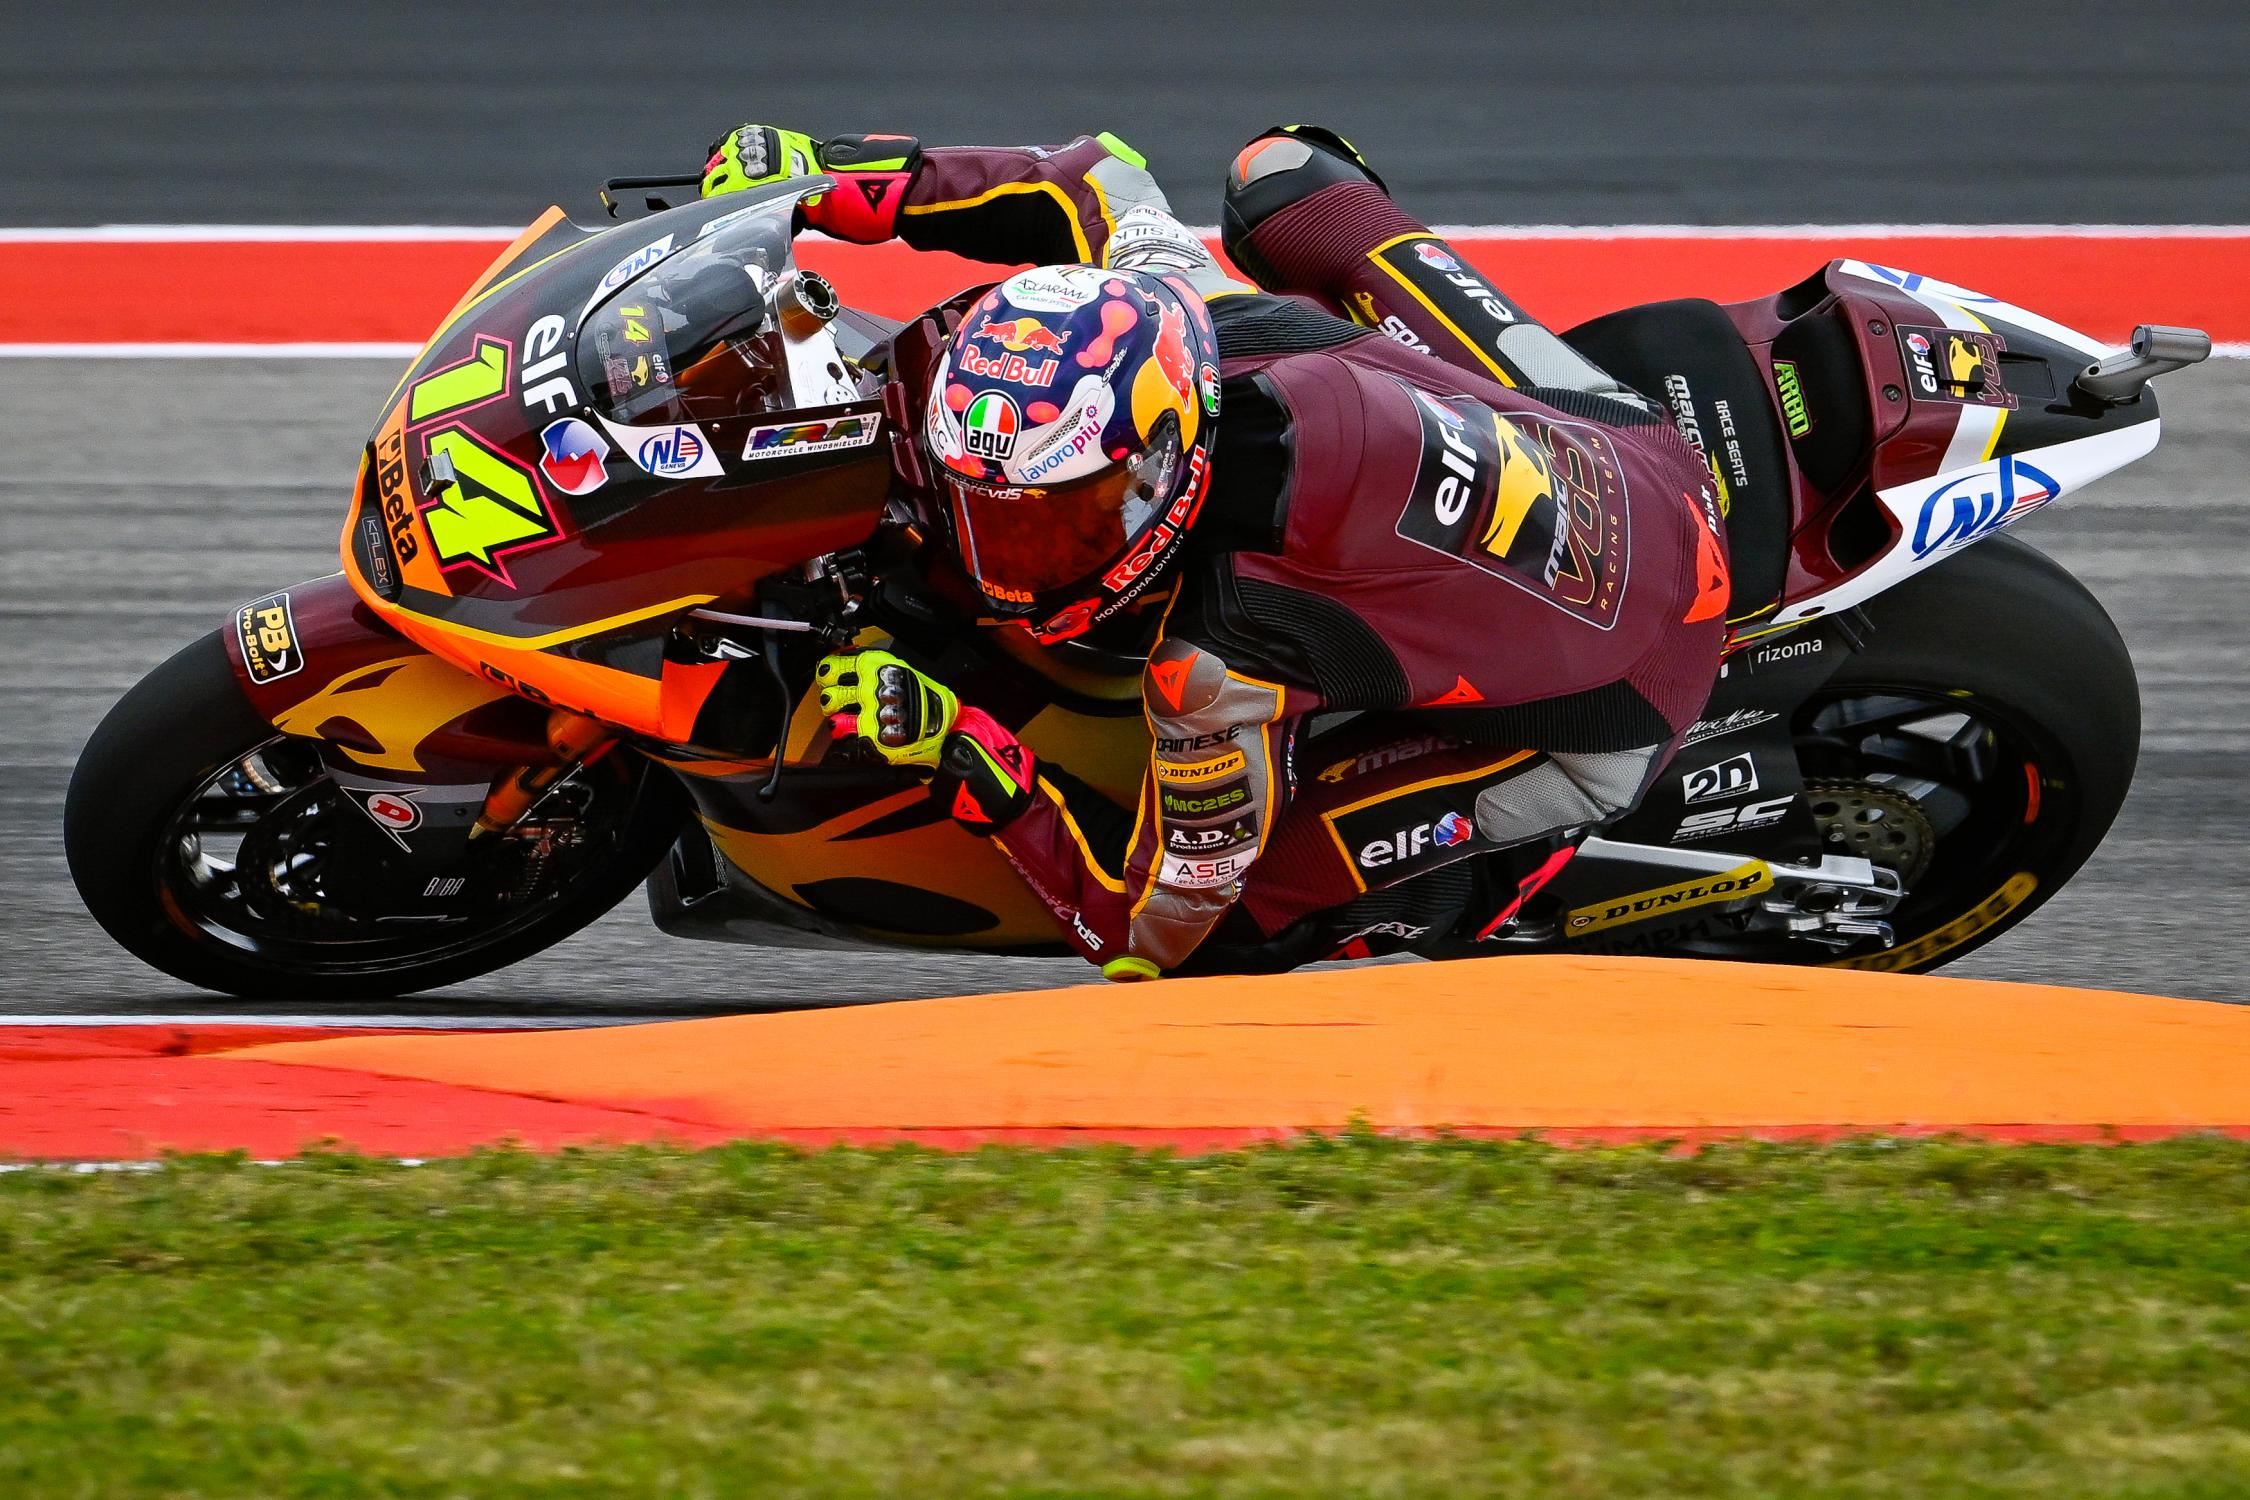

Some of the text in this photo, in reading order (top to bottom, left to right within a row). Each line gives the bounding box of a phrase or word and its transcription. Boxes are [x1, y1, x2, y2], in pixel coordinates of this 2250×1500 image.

[1016, 278, 1090, 300] AQUARAMA
[1445, 272, 1516, 323] elf
[620, 303, 650, 346] 14
[522, 314, 579, 413] elf
[652, 353, 668, 375] elf
[959, 344, 1059, 388] Red Bull
[1912, 353, 1938, 393] elf
[405, 335, 558, 573] 14
[648, 427, 687, 475] NL
[747, 438, 864, 459] MOTORCYCLE WINDSHIELDS
[968, 429, 1012, 457] agv
[1714, 400, 1749, 487] RACE SEATS
[1434, 421, 1477, 526] elf
[379, 458, 419, 568] Beta
[1102, 443, 1206, 593] Red Bull
[1590, 437, 1619, 611] RACING TEAM
[366, 519, 389, 585] KALEX
[994, 585, 1035, 603] Beta
[1094, 532, 1185, 623] MONDOMALDIVE.IT
[242, 607, 267, 671] Pro-Bolt
[256, 606, 292, 653] PB
[1757, 638, 1823, 664] rizoma
[1156, 722, 1244, 753] DAINESE
[1169, 757, 1240, 778] DUNLOP
[1686, 756, 1753, 804] 2D
[1674, 795, 1796, 836] SC
[1169, 840, 1226, 851] Produzione
[1176, 858, 1245, 879] ASEL
[1359, 823, 1431, 868] elf
[1602, 870, 1762, 921] DUNLOP
